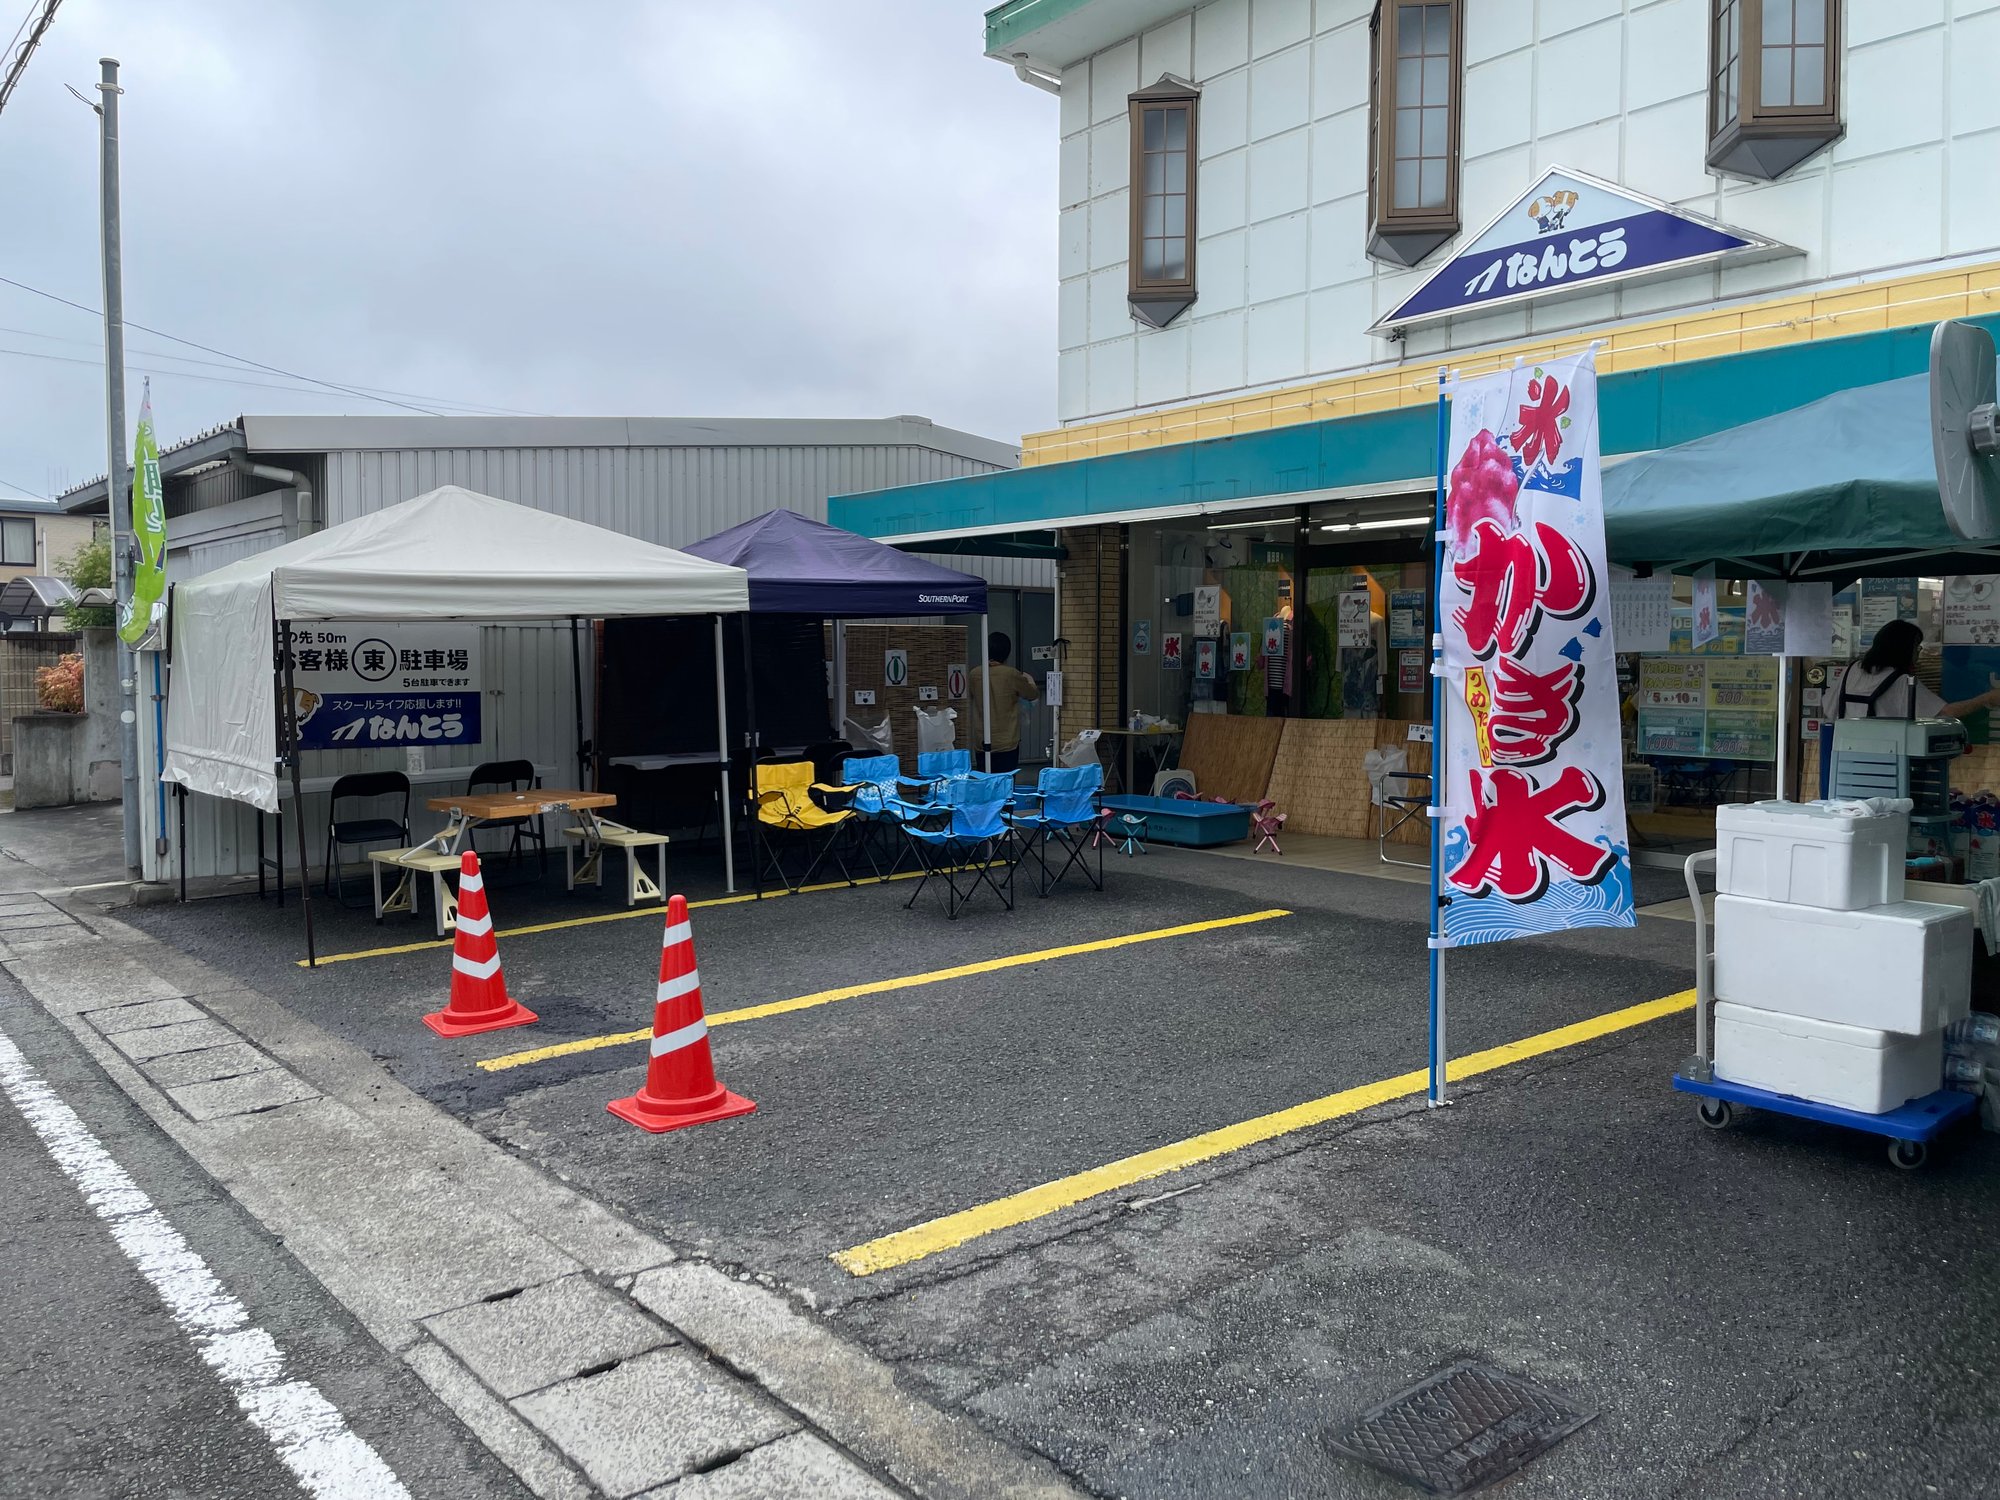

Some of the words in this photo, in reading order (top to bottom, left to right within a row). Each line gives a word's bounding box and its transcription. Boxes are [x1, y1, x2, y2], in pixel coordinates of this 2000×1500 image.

[1505, 227, 1627, 288] なんとう
[1511, 374, 1571, 466] 氷
[317, 632, 347, 644] 50m
[1164, 637, 1179, 657] 氷
[363, 649, 385, 671] 東
[399, 649, 469, 671] 駐車場
[403, 678, 470, 688] 5台駐車できます
[332, 698, 462, 711] スクールライフ応援します!!
[1449, 516, 1616, 904] かき氷
[369, 712, 464, 741] なんとう
